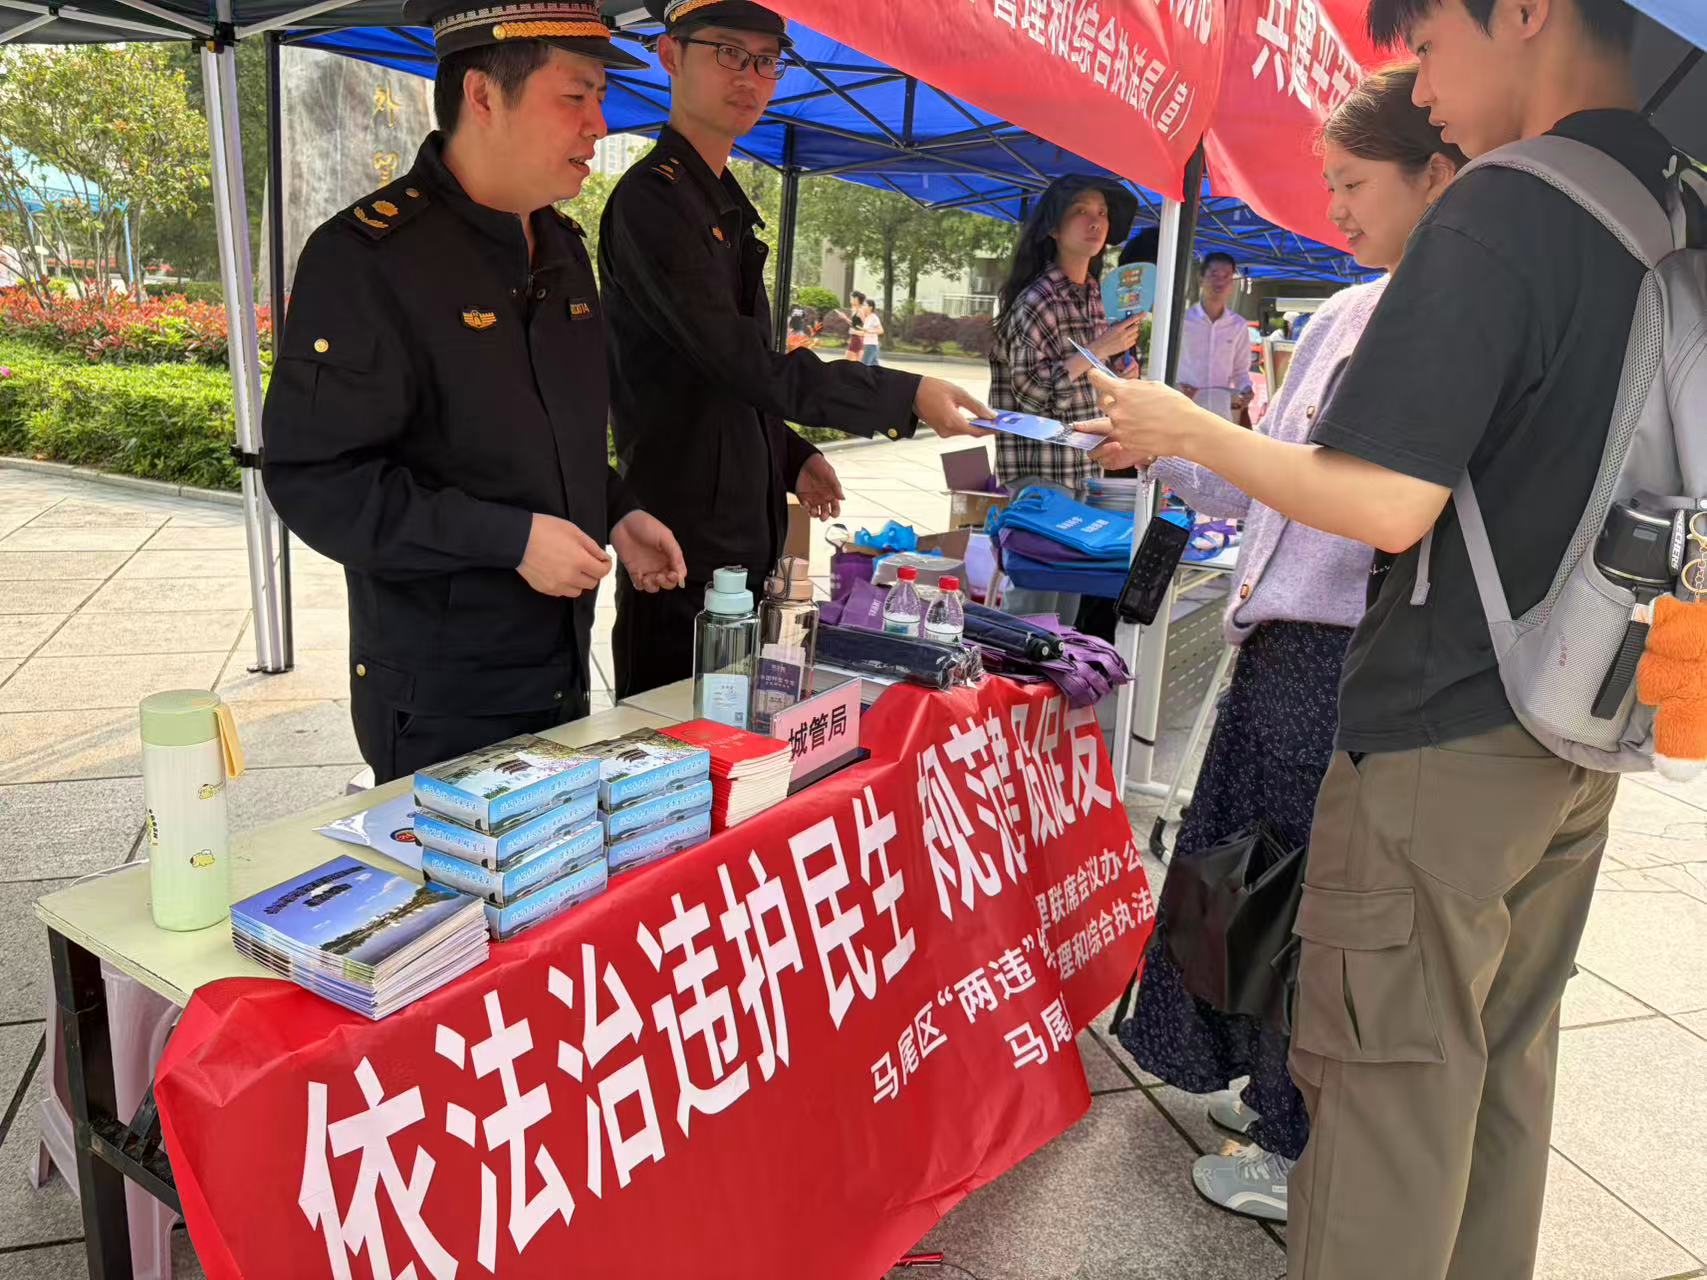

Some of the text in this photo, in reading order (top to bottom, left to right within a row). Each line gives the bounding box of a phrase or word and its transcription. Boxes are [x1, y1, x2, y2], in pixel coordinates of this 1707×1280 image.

[788, 704, 848, 762] 城管局
[298, 785, 916, 1280] 依法治违护民生
